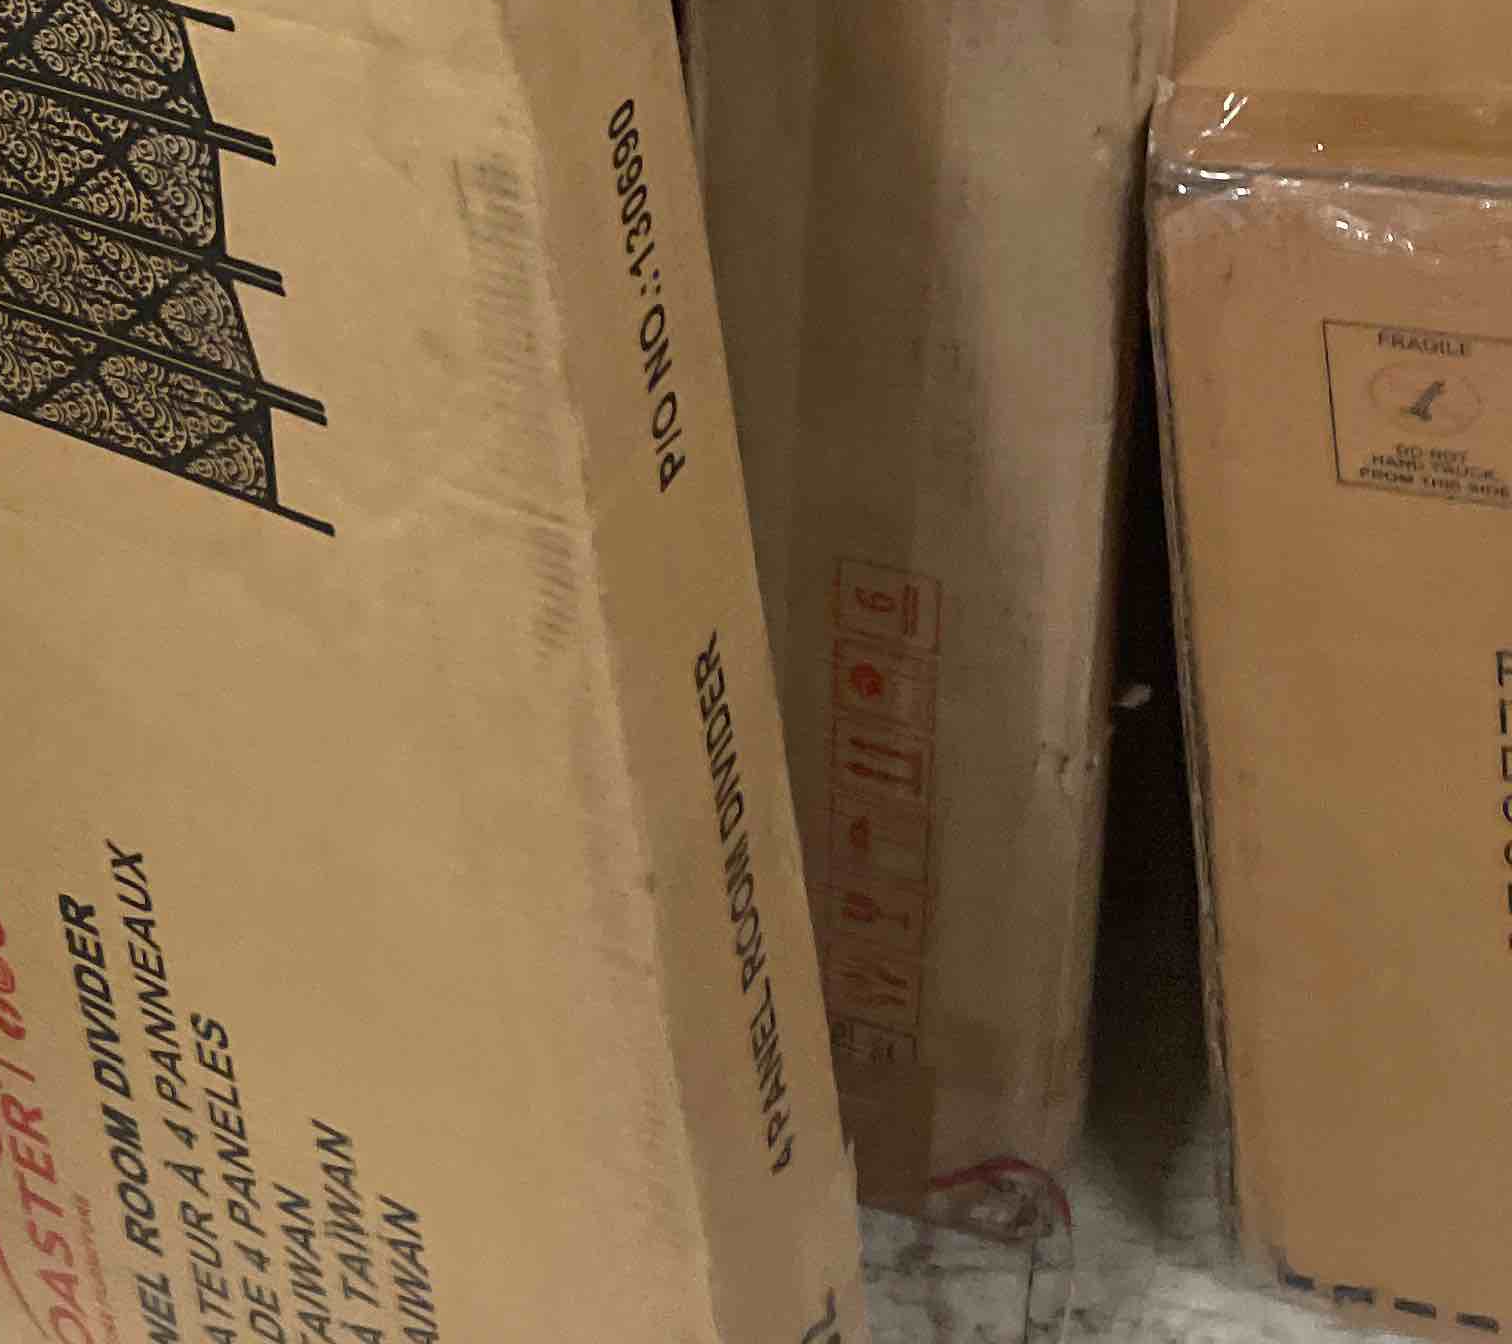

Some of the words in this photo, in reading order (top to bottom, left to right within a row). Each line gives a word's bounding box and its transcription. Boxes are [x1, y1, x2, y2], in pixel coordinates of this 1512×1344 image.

[651, 390, 687, 494] P/O
[694, 629, 747, 844] DIVIDER
[104, 837, 194, 1113] PANNEAUX
[723, 831, 766, 995] ROOM
[59, 893, 134, 1101] DIVIDER
[749, 975, 791, 1151] PANEL
[100, 1102, 165, 1257] ROOM
[162, 1117, 201, 1151] 4
[189, 1012, 267, 1239] PANELES
[231, 1240, 273, 1274] 4
[271, 1181, 336, 1344] AIWAN
[311, 1118, 382, 1311] TAIWAN
[240, 1273, 285, 1344] DE
